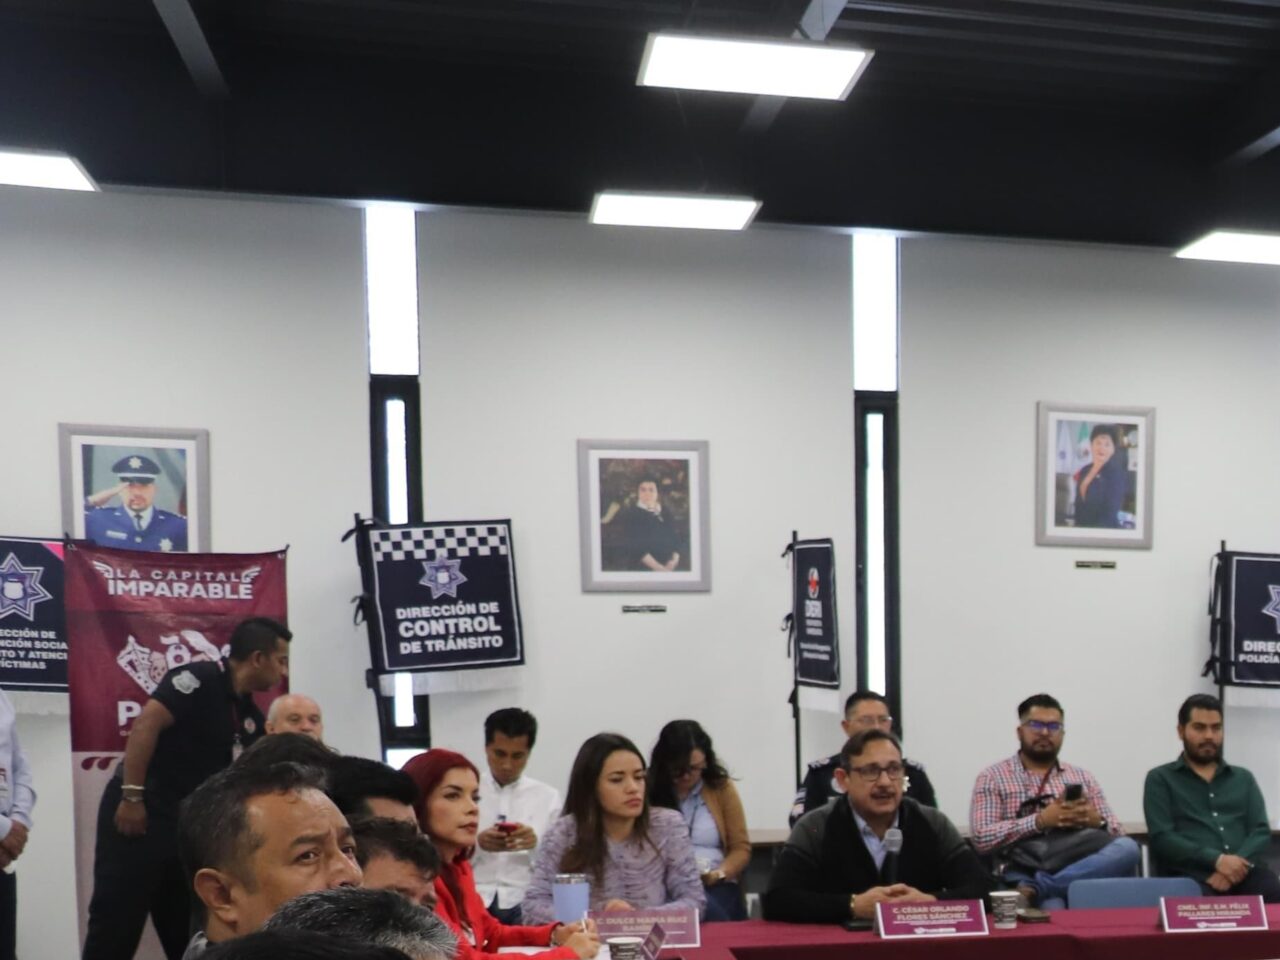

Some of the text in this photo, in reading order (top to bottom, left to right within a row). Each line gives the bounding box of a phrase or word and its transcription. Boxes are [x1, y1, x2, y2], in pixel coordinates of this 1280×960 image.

[117, 568, 240, 583] LA CAPITAL
[108, 580, 253, 599] IMPARABLE
[396, 601, 500, 619] DIRECCIÓN DE
[399, 615, 502, 638] CONTROL
[40, 630, 57, 639] DE
[400, 635, 503, 654] DE TRÁNSITO
[17, 650, 26, 658] Y
[1238, 652, 1280, 664] POLICÍA
[902, 905, 929, 914] CÉSAR
[930, 905, 969, 913] ORLANDO
